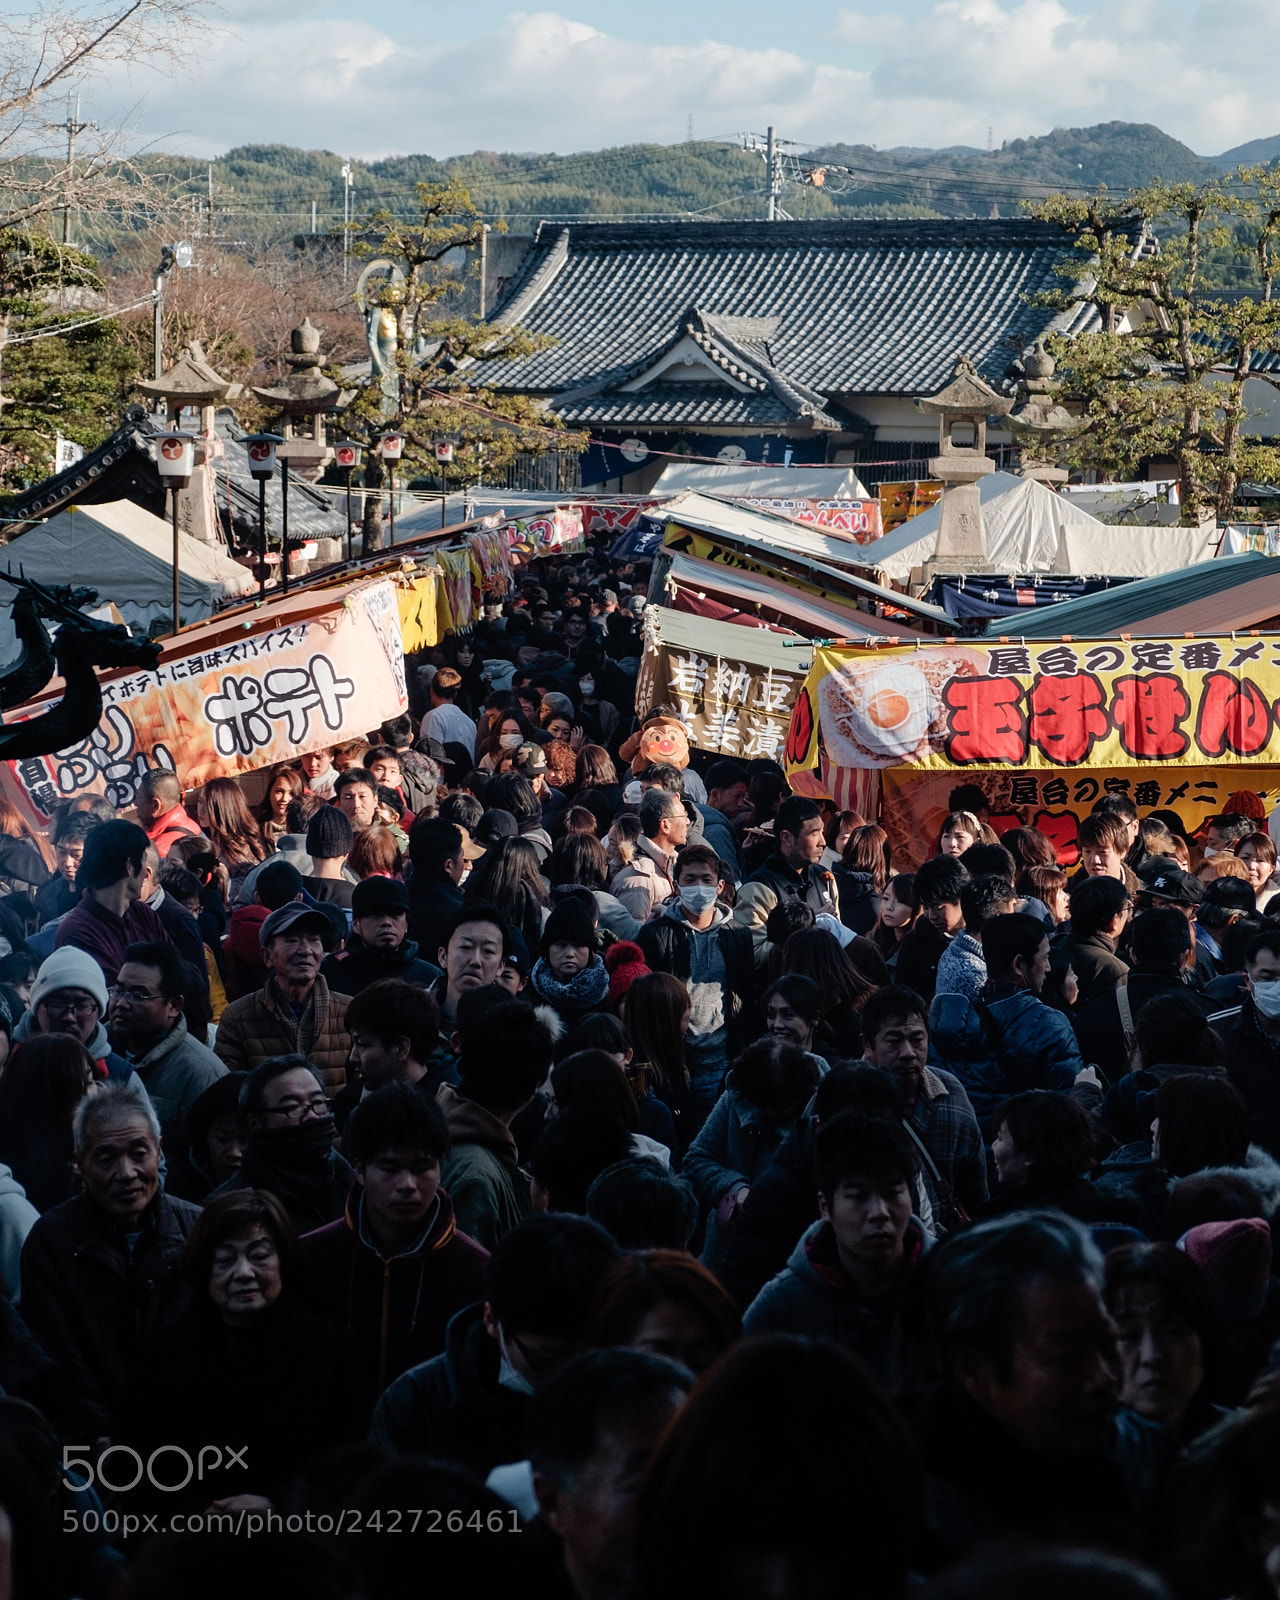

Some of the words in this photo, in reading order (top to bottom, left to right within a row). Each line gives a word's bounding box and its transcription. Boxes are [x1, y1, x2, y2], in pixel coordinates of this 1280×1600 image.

[204, 653, 354, 756] ポテト
[943, 670, 1280, 766] 玉子せん
[1009, 776, 1267, 806] 屋台の定番メニ
